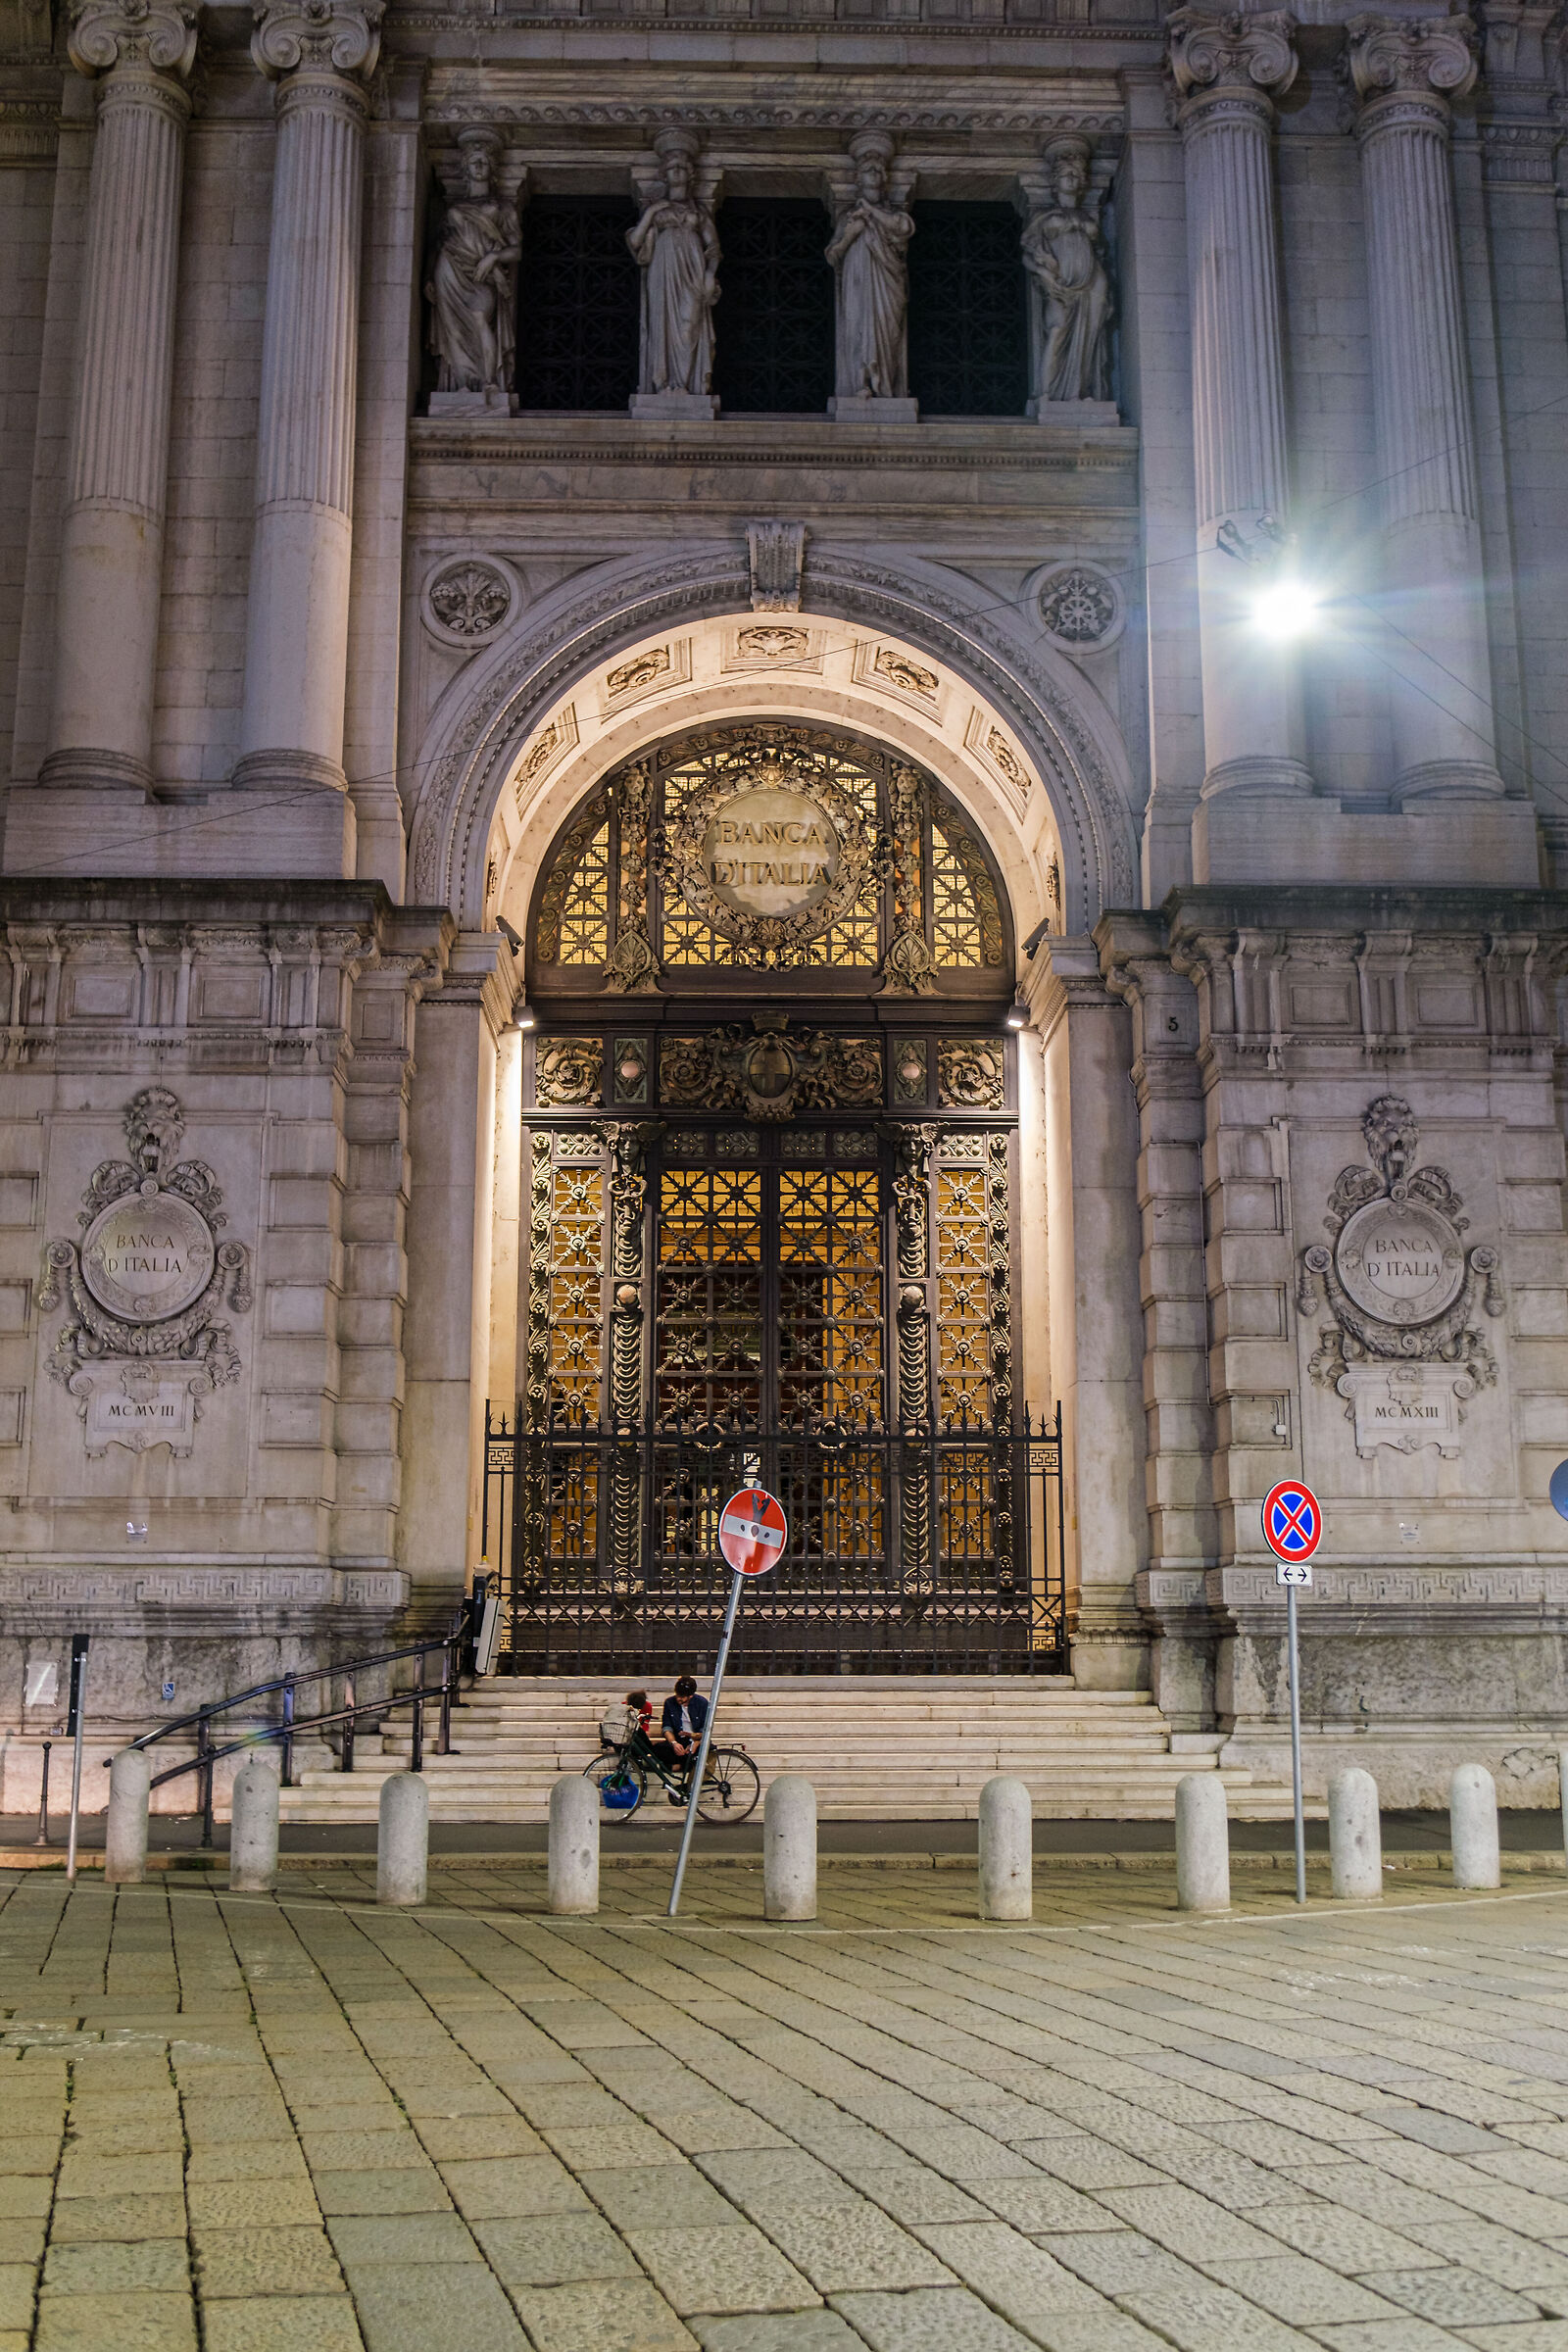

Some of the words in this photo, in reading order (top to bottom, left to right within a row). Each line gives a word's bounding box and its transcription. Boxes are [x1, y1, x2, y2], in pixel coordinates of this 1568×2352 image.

[719, 820, 827, 846] BANCA
[1168, 1015, 1179, 1032] 5
[117, 1234, 174, 1249] BANCA
[1375, 1238, 1434, 1253] BANCA
